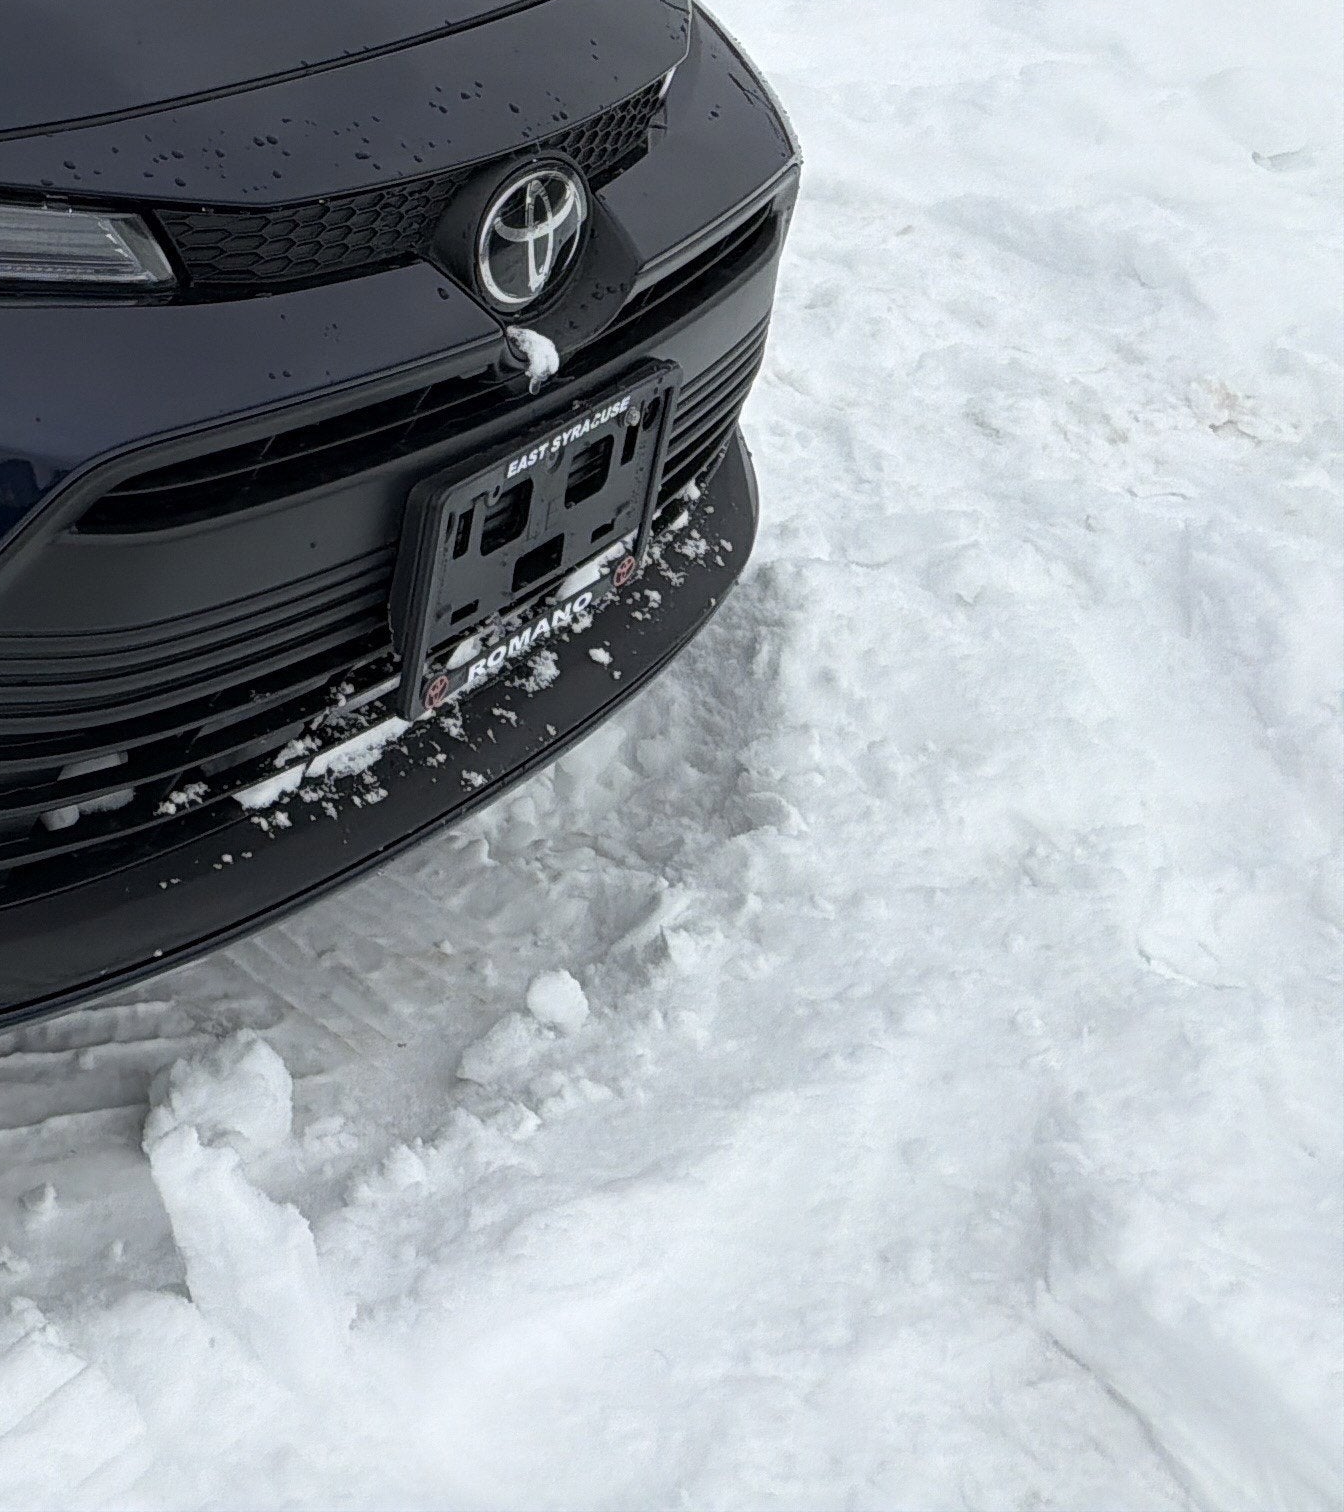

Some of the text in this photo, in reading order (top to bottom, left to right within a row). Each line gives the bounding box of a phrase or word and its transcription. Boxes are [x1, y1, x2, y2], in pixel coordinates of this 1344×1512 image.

[507, 396, 631, 479] EAST SYRACUSE
[466, 591, 594, 683] ROMANO
